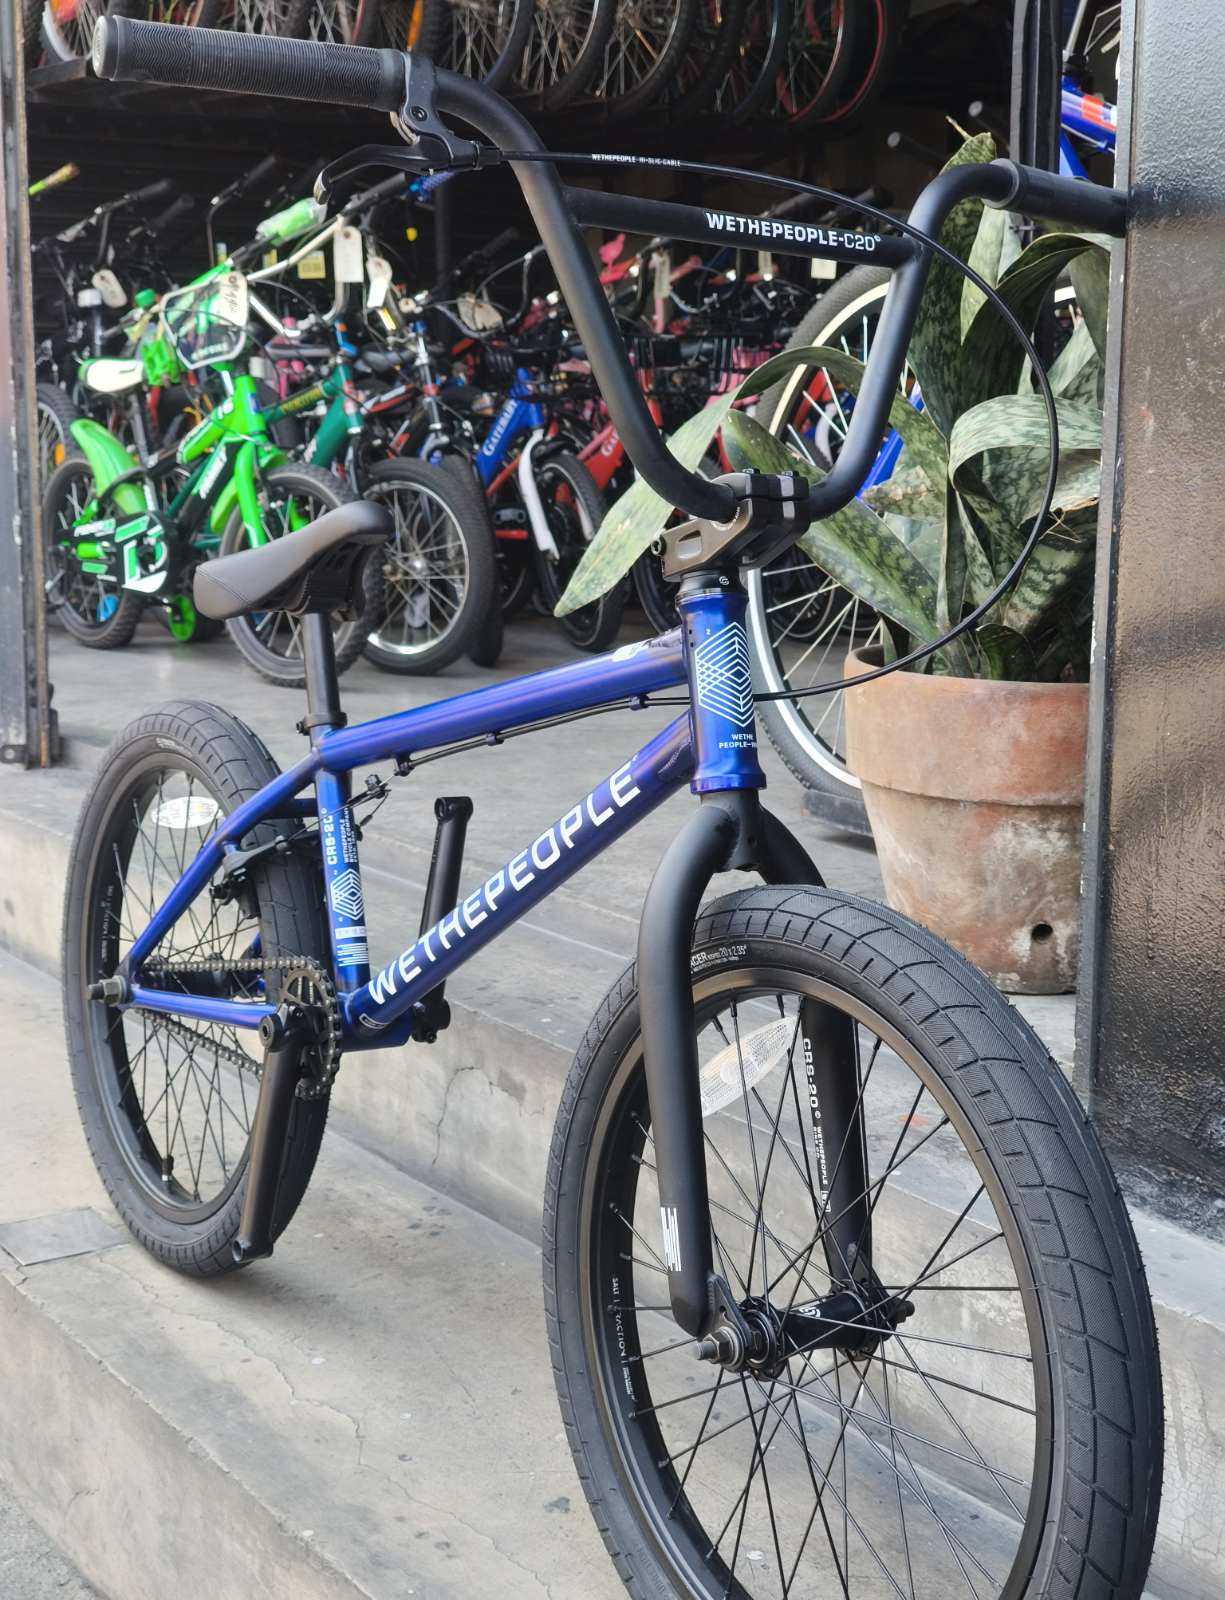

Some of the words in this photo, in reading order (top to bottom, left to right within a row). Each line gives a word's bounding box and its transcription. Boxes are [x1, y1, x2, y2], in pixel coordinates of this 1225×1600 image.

[592, 153, 636, 163] WETHEPEOPLE
[368, 760, 642, 1005] WETHEPEOPLE
[816, 1126, 828, 1185] WETHEPEOPLE
